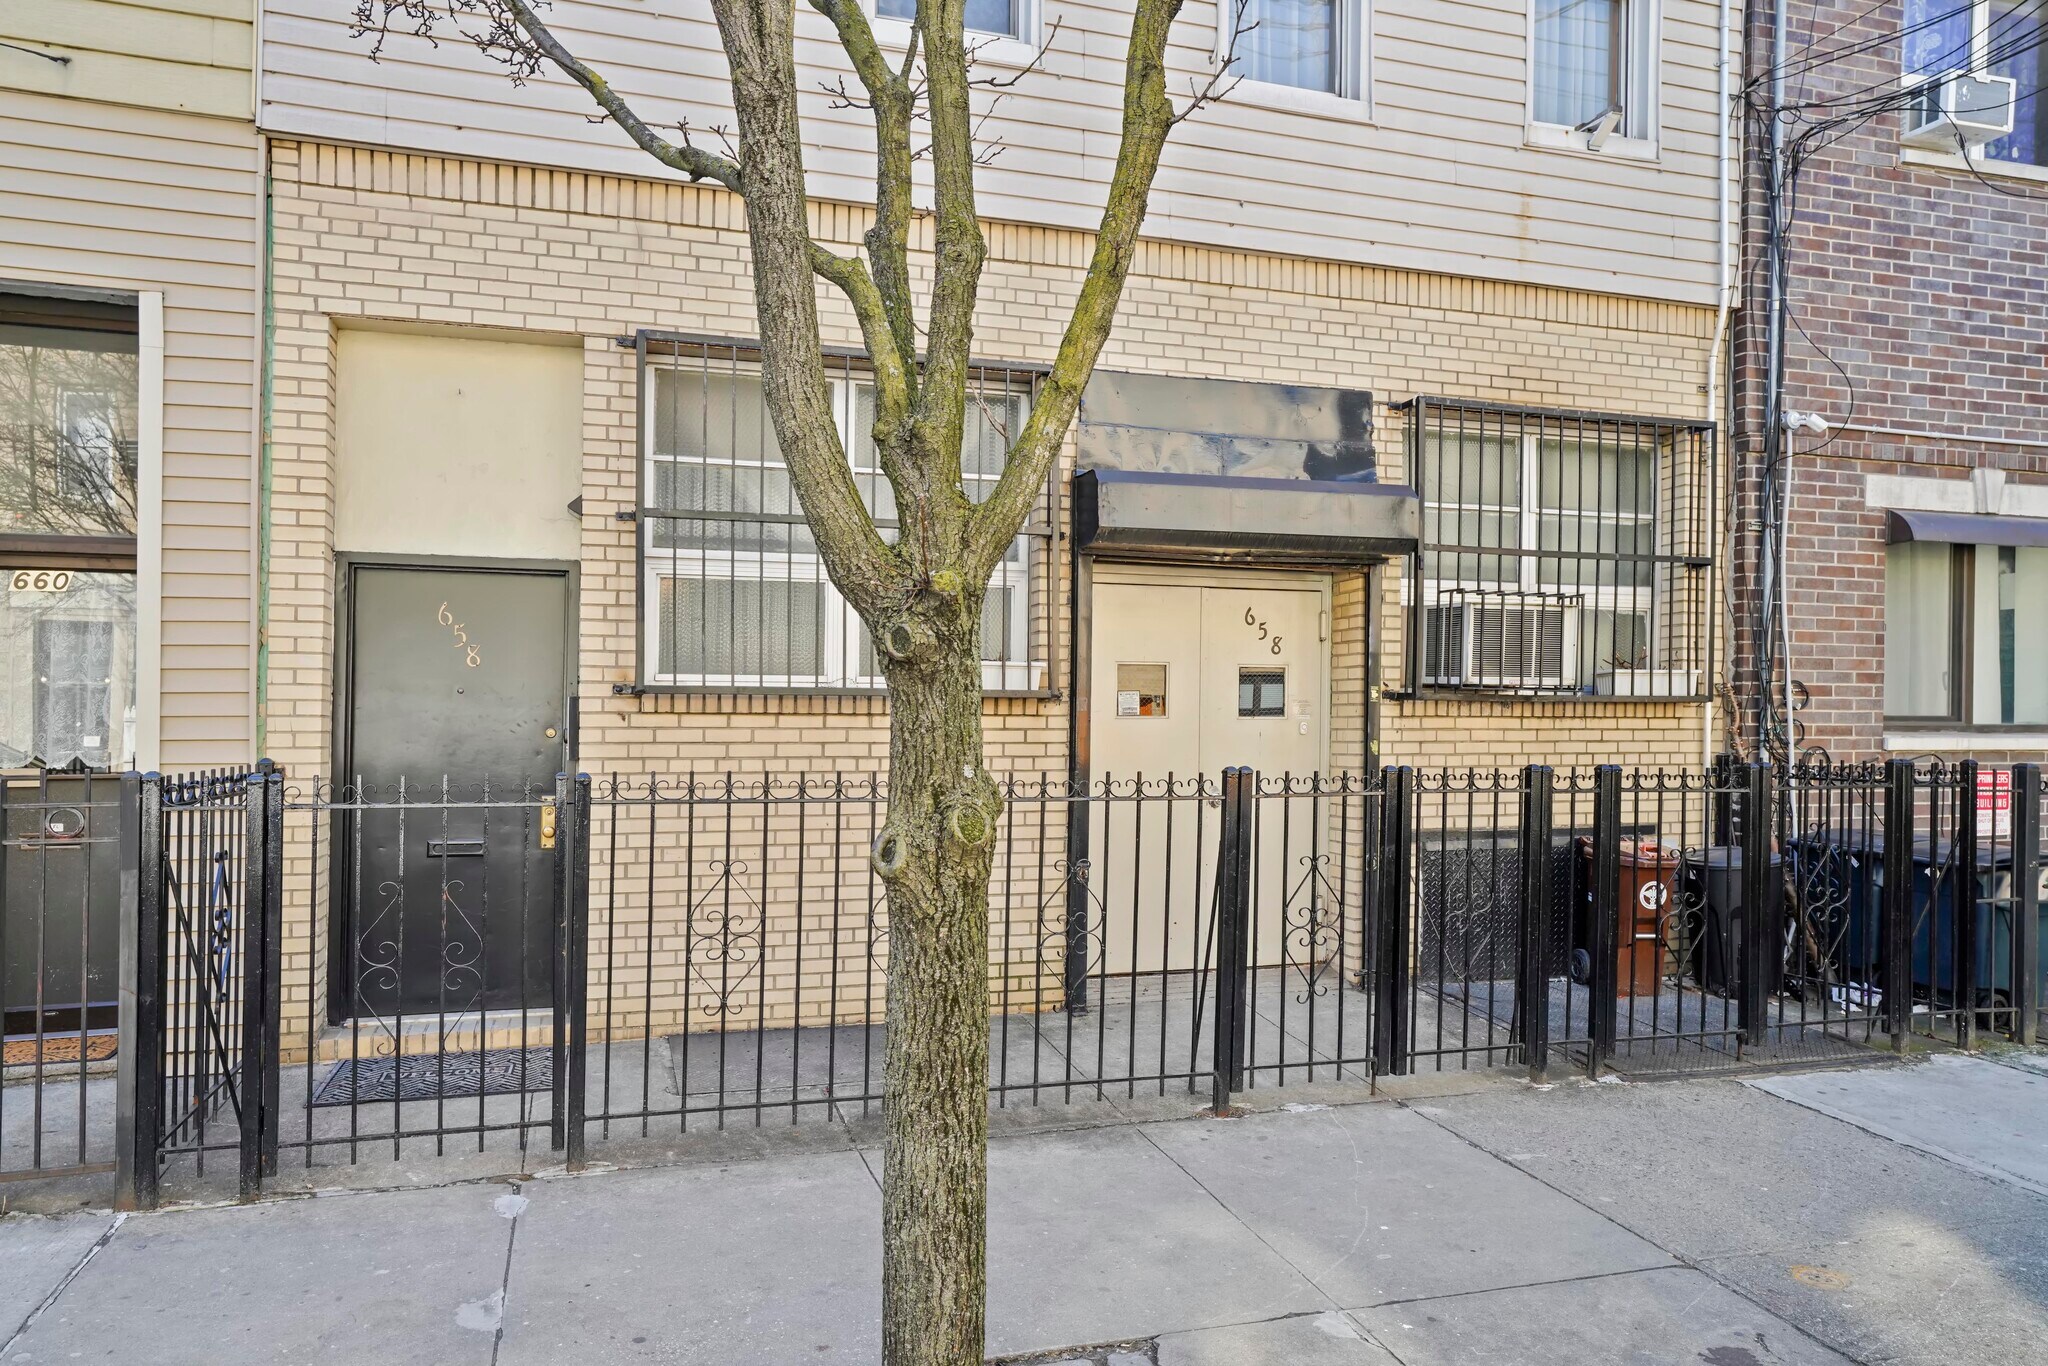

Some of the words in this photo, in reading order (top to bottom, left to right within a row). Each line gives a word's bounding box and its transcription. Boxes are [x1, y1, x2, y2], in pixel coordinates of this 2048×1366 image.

[13, 571, 69, 590] 660
[438, 601, 481, 668] 658
[1244, 606, 1283, 655] 658
[1976, 798, 2007, 808] BUILING
